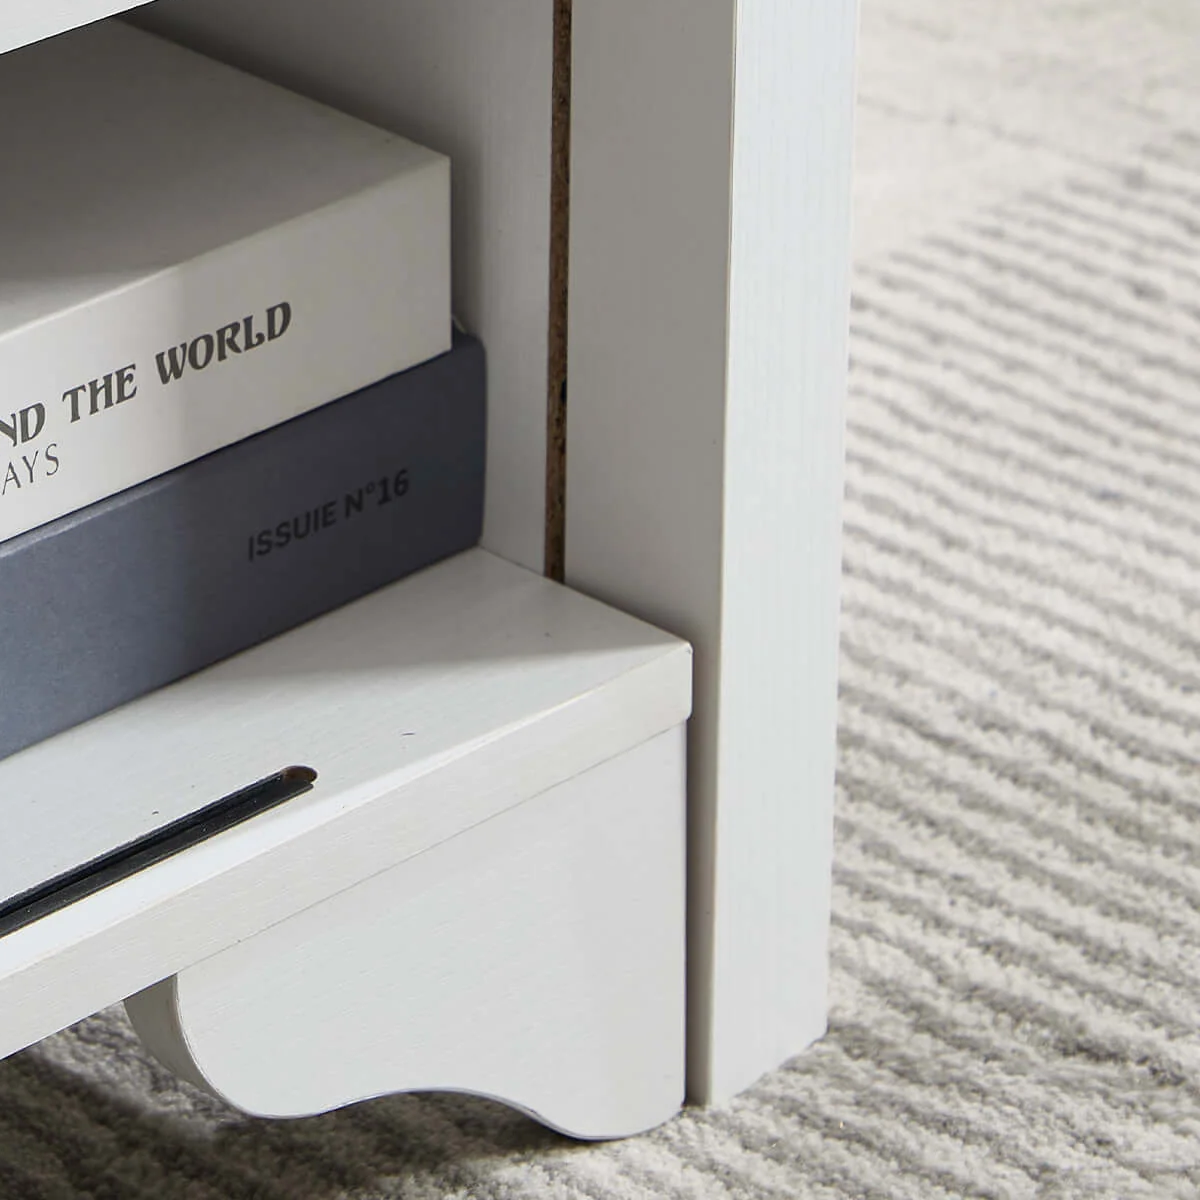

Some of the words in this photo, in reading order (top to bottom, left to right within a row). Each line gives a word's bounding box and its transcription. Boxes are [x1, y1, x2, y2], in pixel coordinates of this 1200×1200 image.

[62, 364, 137, 424] THE
[154, 301, 291, 385] WORLD
[248, 501, 337, 562] ISSUIE
